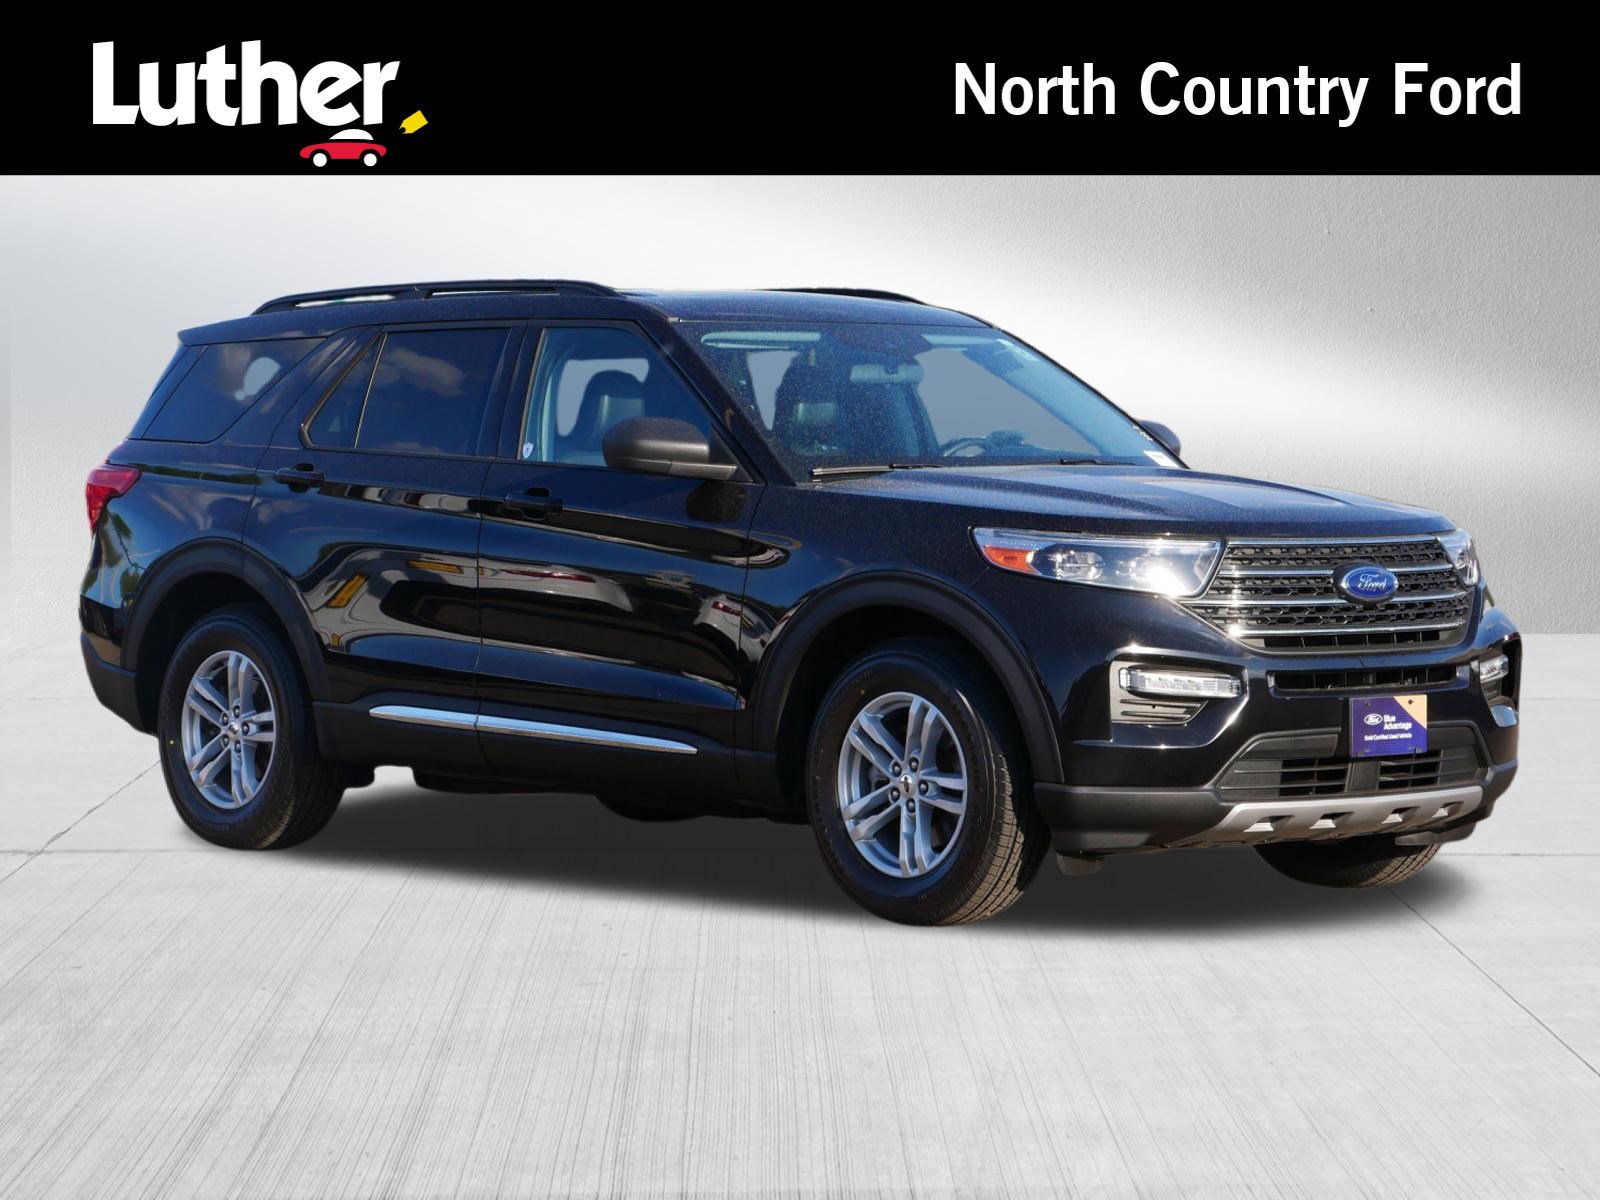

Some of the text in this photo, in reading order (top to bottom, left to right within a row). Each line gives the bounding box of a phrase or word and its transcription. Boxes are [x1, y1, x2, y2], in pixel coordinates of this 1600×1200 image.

[1357, 573, 1387, 592] Ford
[1383, 714, 1396, 722] Blue
[1384, 722, 1412, 730] Advantage
